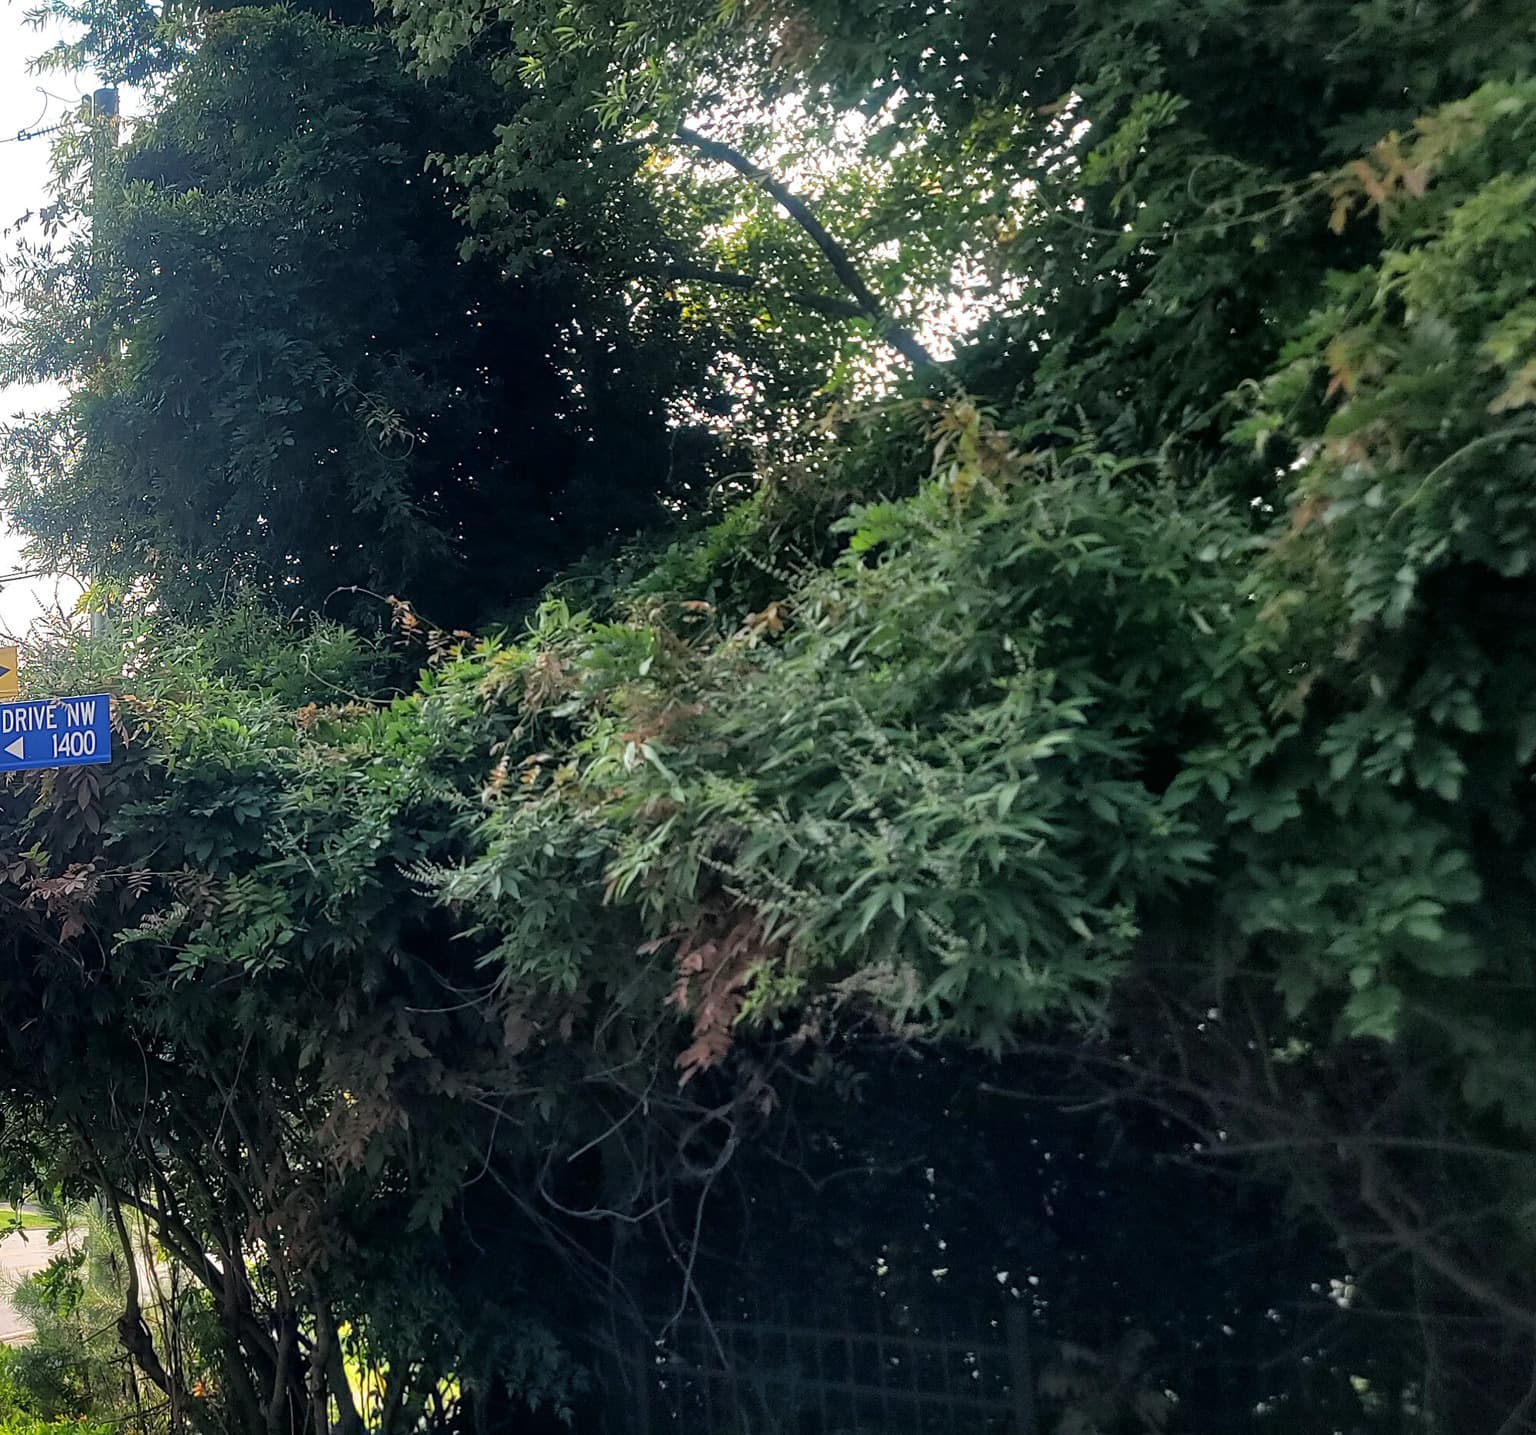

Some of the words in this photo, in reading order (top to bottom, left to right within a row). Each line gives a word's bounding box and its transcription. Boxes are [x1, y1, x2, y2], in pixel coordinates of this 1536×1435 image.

[2, 705, 57, 733] DRIVE
[67, 701, 95, 727] NW
[52, 730, 95, 758] 1400
